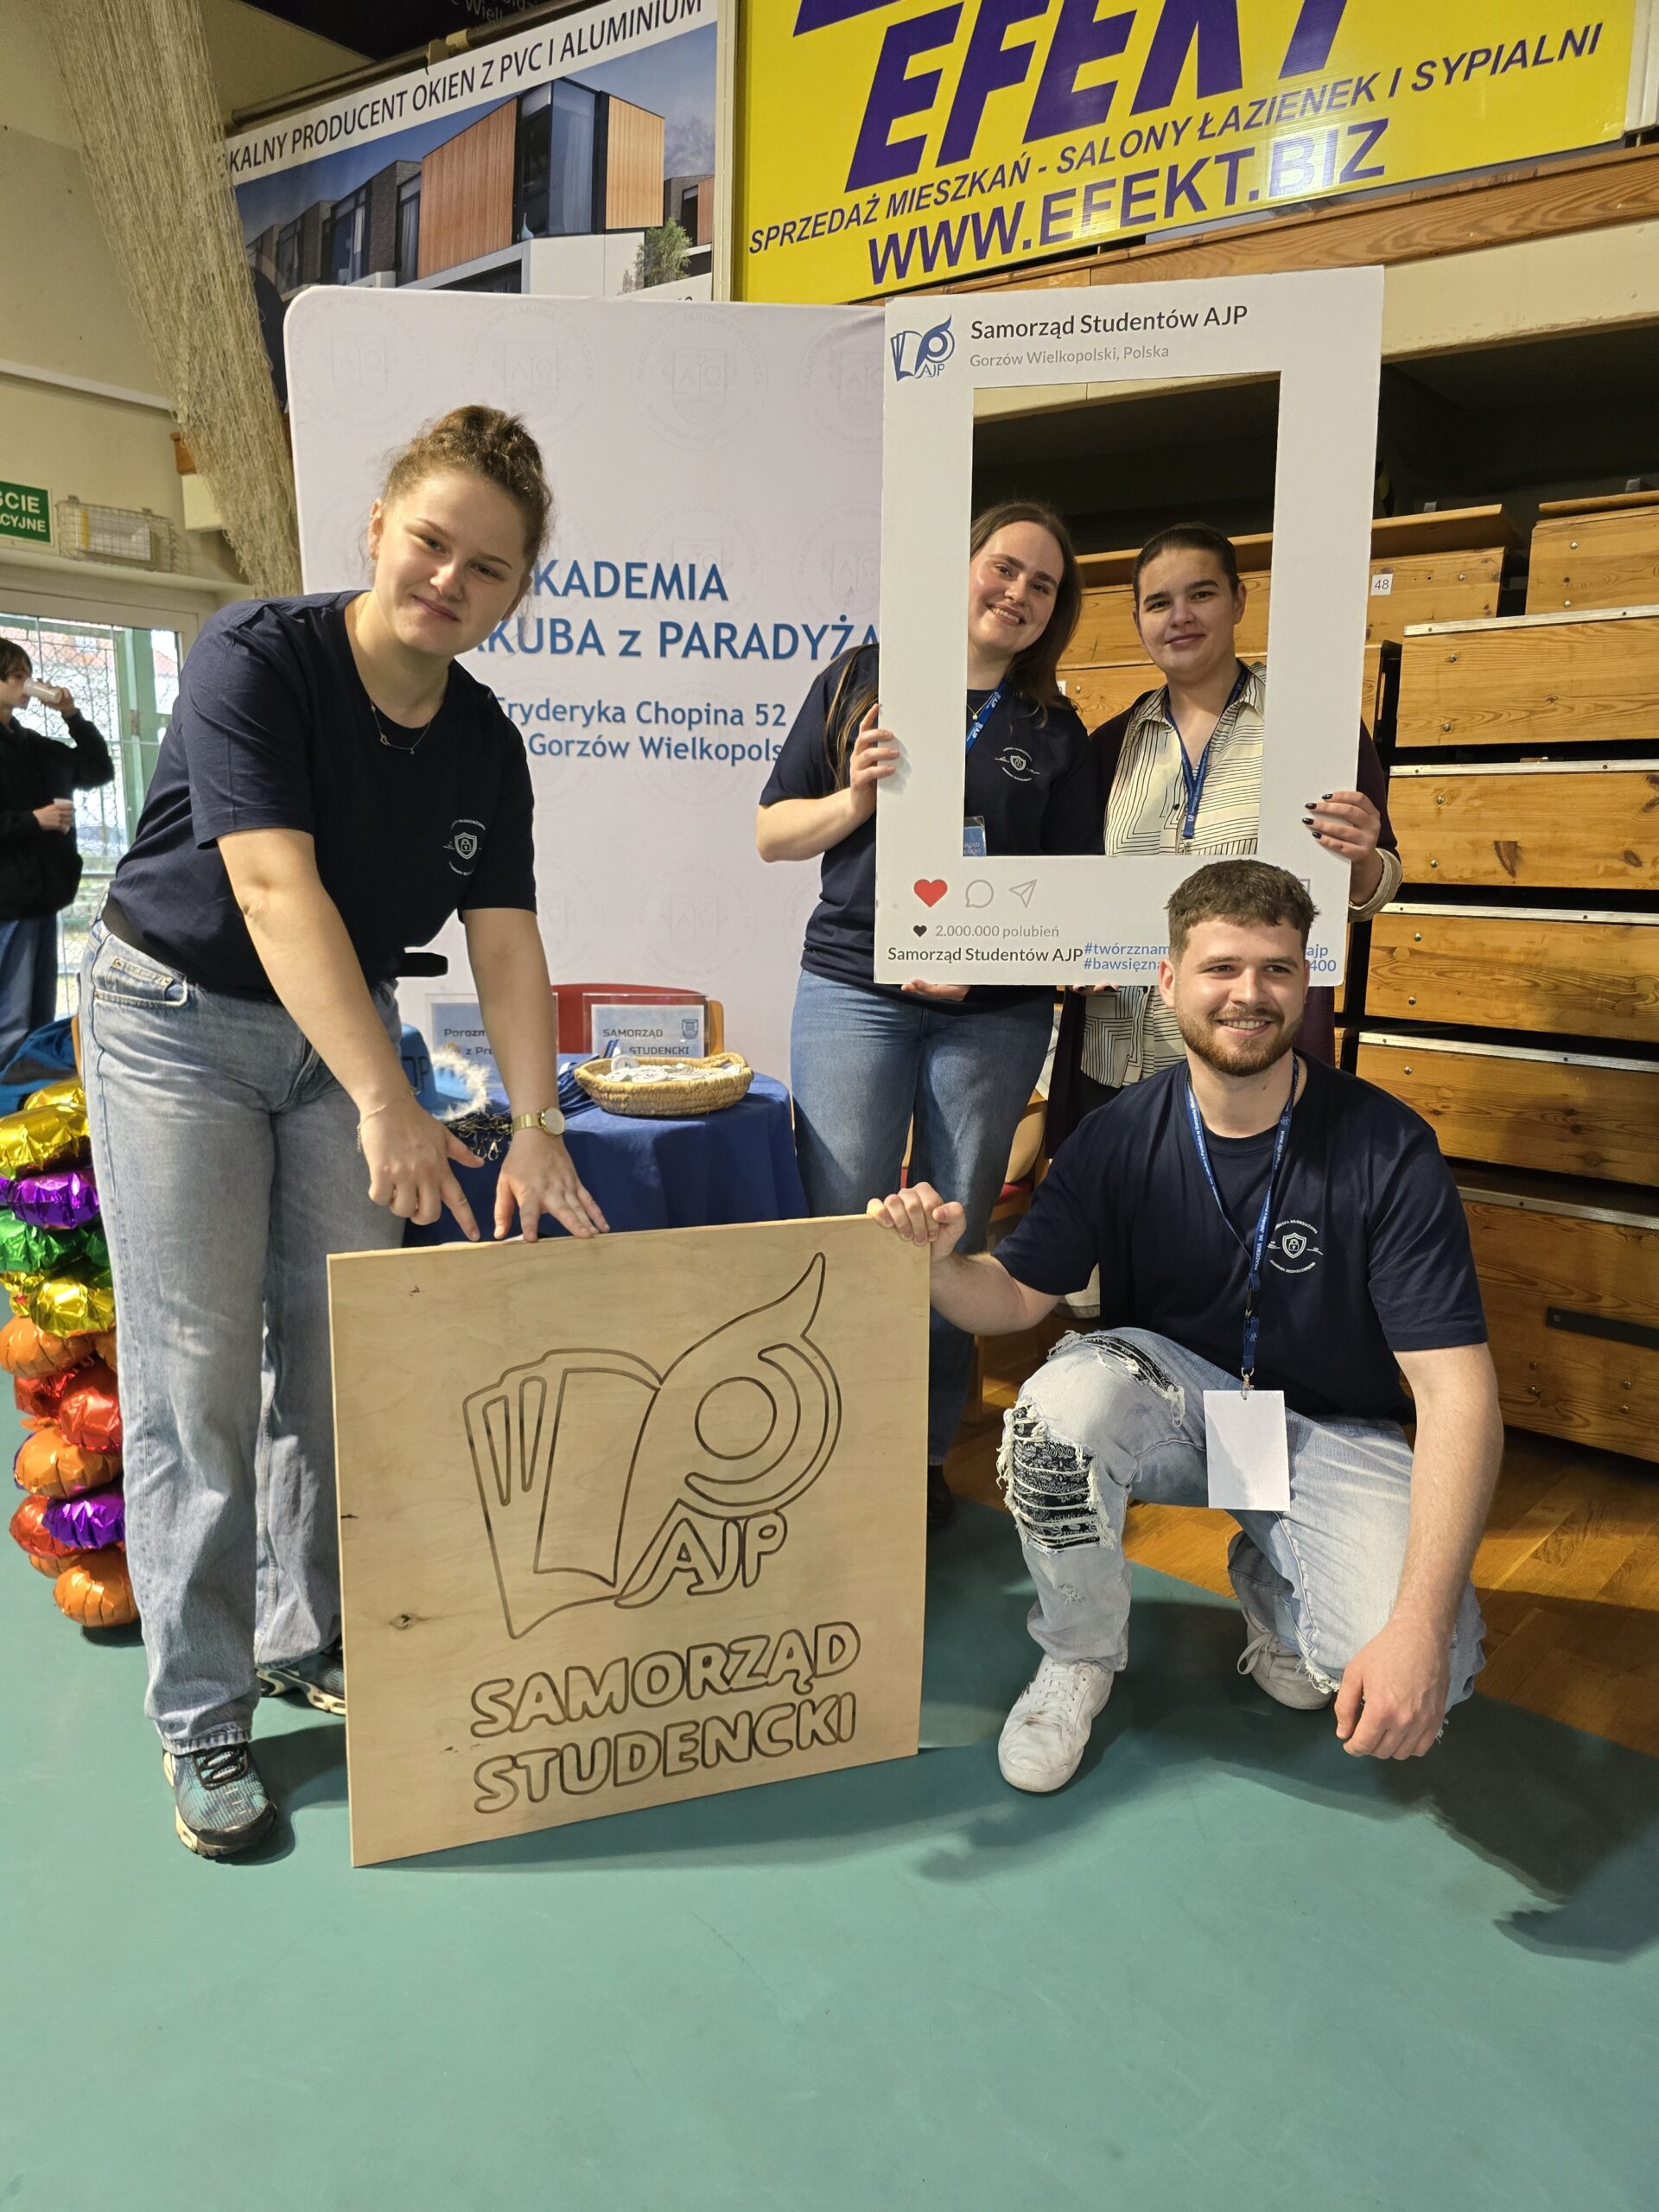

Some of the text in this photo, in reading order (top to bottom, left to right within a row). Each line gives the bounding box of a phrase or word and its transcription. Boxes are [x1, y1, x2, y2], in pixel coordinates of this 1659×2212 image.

[228, 0, 702, 173] KALNY PRODUCENT OKIEN Z PVC I ALUMINIUM
[749, 193, 882, 255] SPRZEDAŻ
[886, 152, 1031, 219] MIESZKAŃ
[1058, 115, 1192, 174] SALONY
[1197, 71, 1381, 140] ŁAZIENEK
[1388, 67, 1402, 98] I
[1411, 22, 1603, 92] SYPIALNI
[868, 118, 1389, 285] WWW.EFEKT.BIZ
[970, 304, 1248, 340] Samorząd Studentów AJP
[915, 363, 945, 378] AJP
[969, 344, 1169, 368] Gorzów Wielkopolski, Polska
[0, 513, 47, 532] CYJNE
[533, 559, 728, 601] KADEMIA
[1374, 579, 1389, 590] 48
[478, 617, 605, 657] KUBA
[619, 629, 641, 658] z
[496, 696, 626, 728] ryderyka
[636, 700, 744, 731] Chopina
[755, 703, 786, 727] 52
[528, 733, 783, 766] Gorzów Wielkopols
[935, 924, 1059, 940] 2.000.000 polubień
[887, 946, 1084, 963] Samorząd Studentów AJP
[1084, 942, 1328, 958] #twórzznam ajp
[1309, 959, 1337, 972] 400
[603, 1029, 663, 1039] SAMORZĄD
[629, 1046, 690, 1055] STUDENCKI
[613, 1510, 788, 1609] AJP
[470, 1622, 861, 1738] SAMORZĄD
[474, 1692, 857, 1814] STUDENCKI
